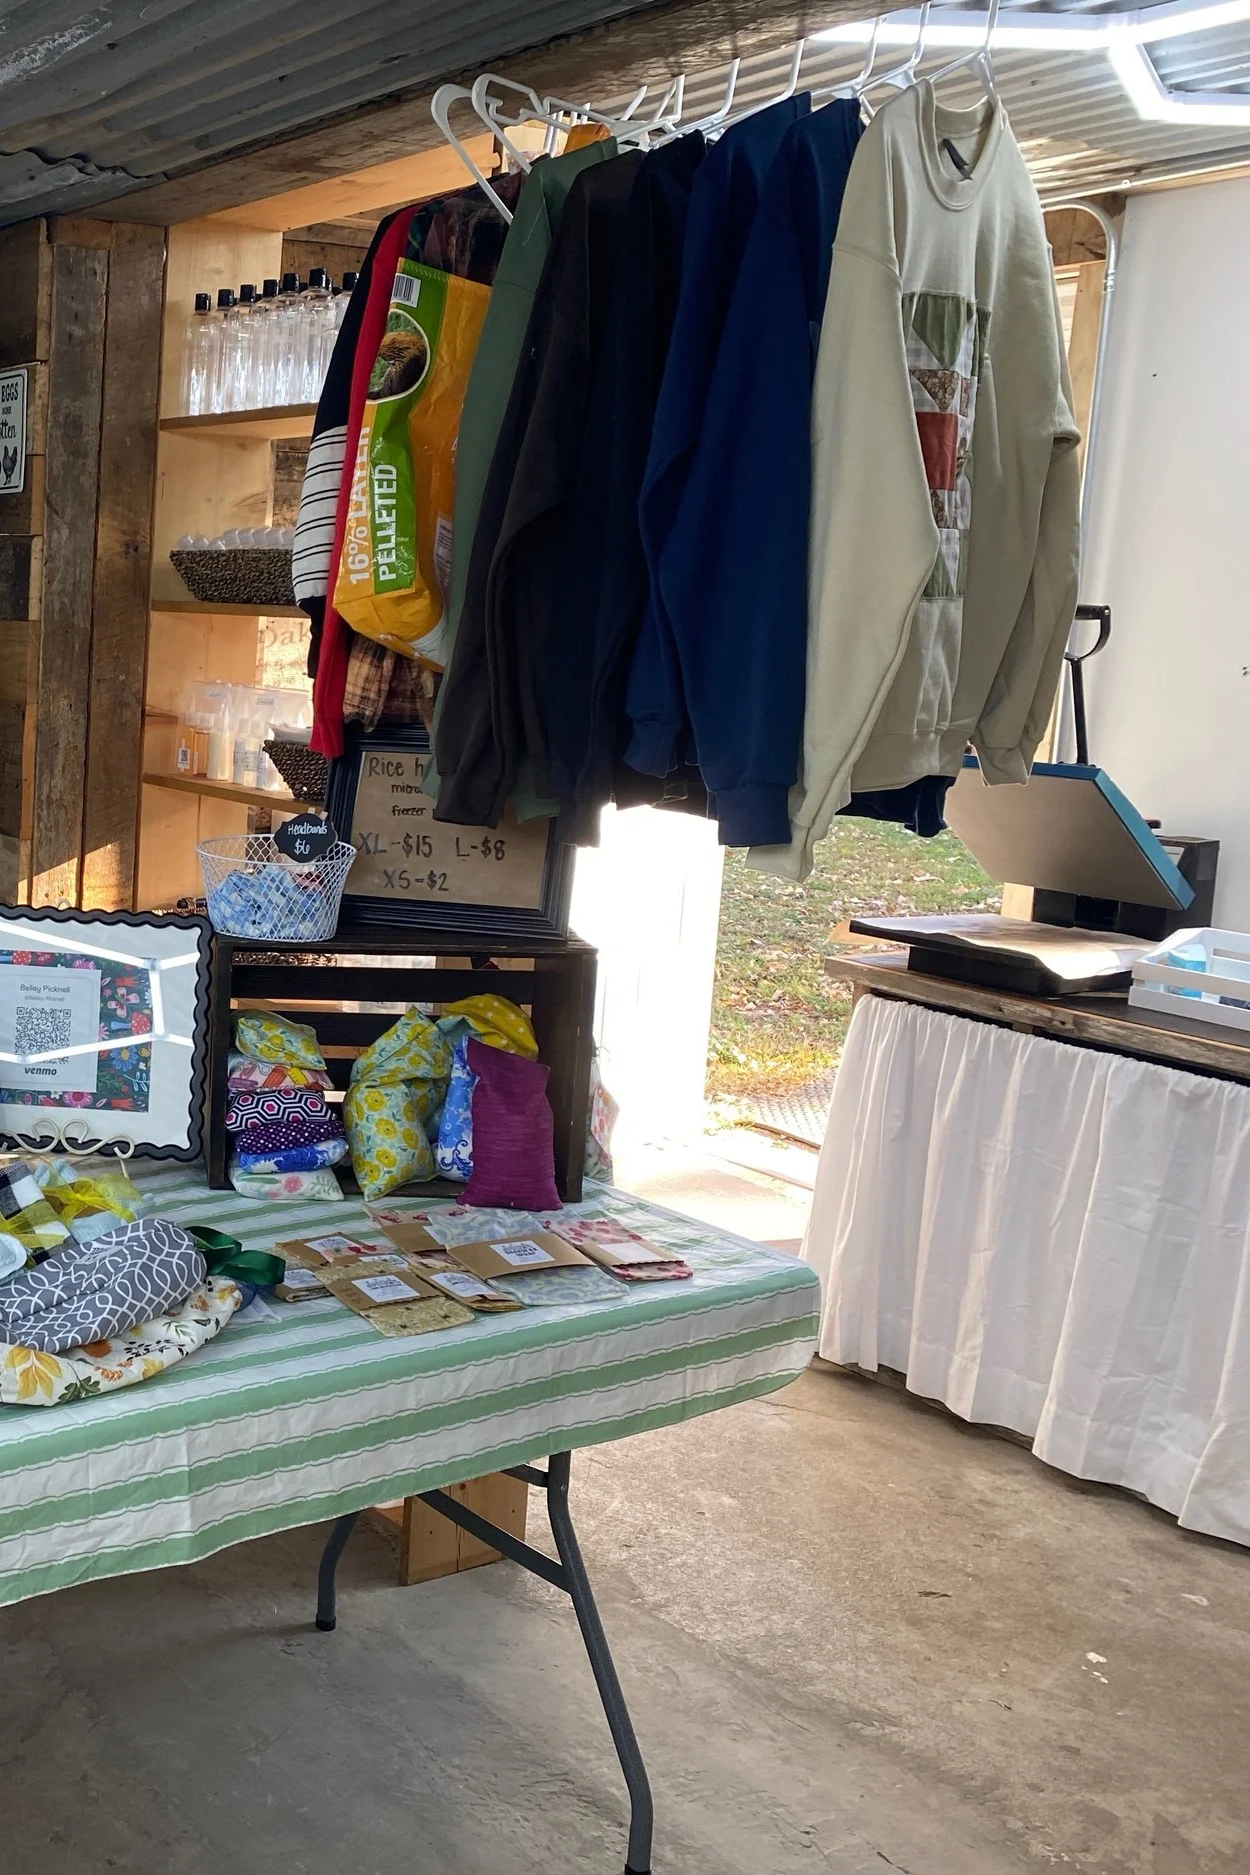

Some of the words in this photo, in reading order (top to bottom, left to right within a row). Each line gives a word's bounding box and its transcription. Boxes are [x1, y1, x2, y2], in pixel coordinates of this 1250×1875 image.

[1, 382, 19, 403] EGGS
[2, 406, 12, 415] SOME
[374, 464, 398, 581] PELLETED
[347, 526, 370, 585] 16%
[368, 756, 405, 777] Rice
[392, 804, 427, 817] freezer
[287, 820, 328, 835] Headbands
[293, 838, 310, 855] $6
[20, 984, 42, 994] Bailey
[42, 985, 70, 993] Picknell
[24, 1066, 57, 1076] venmo
